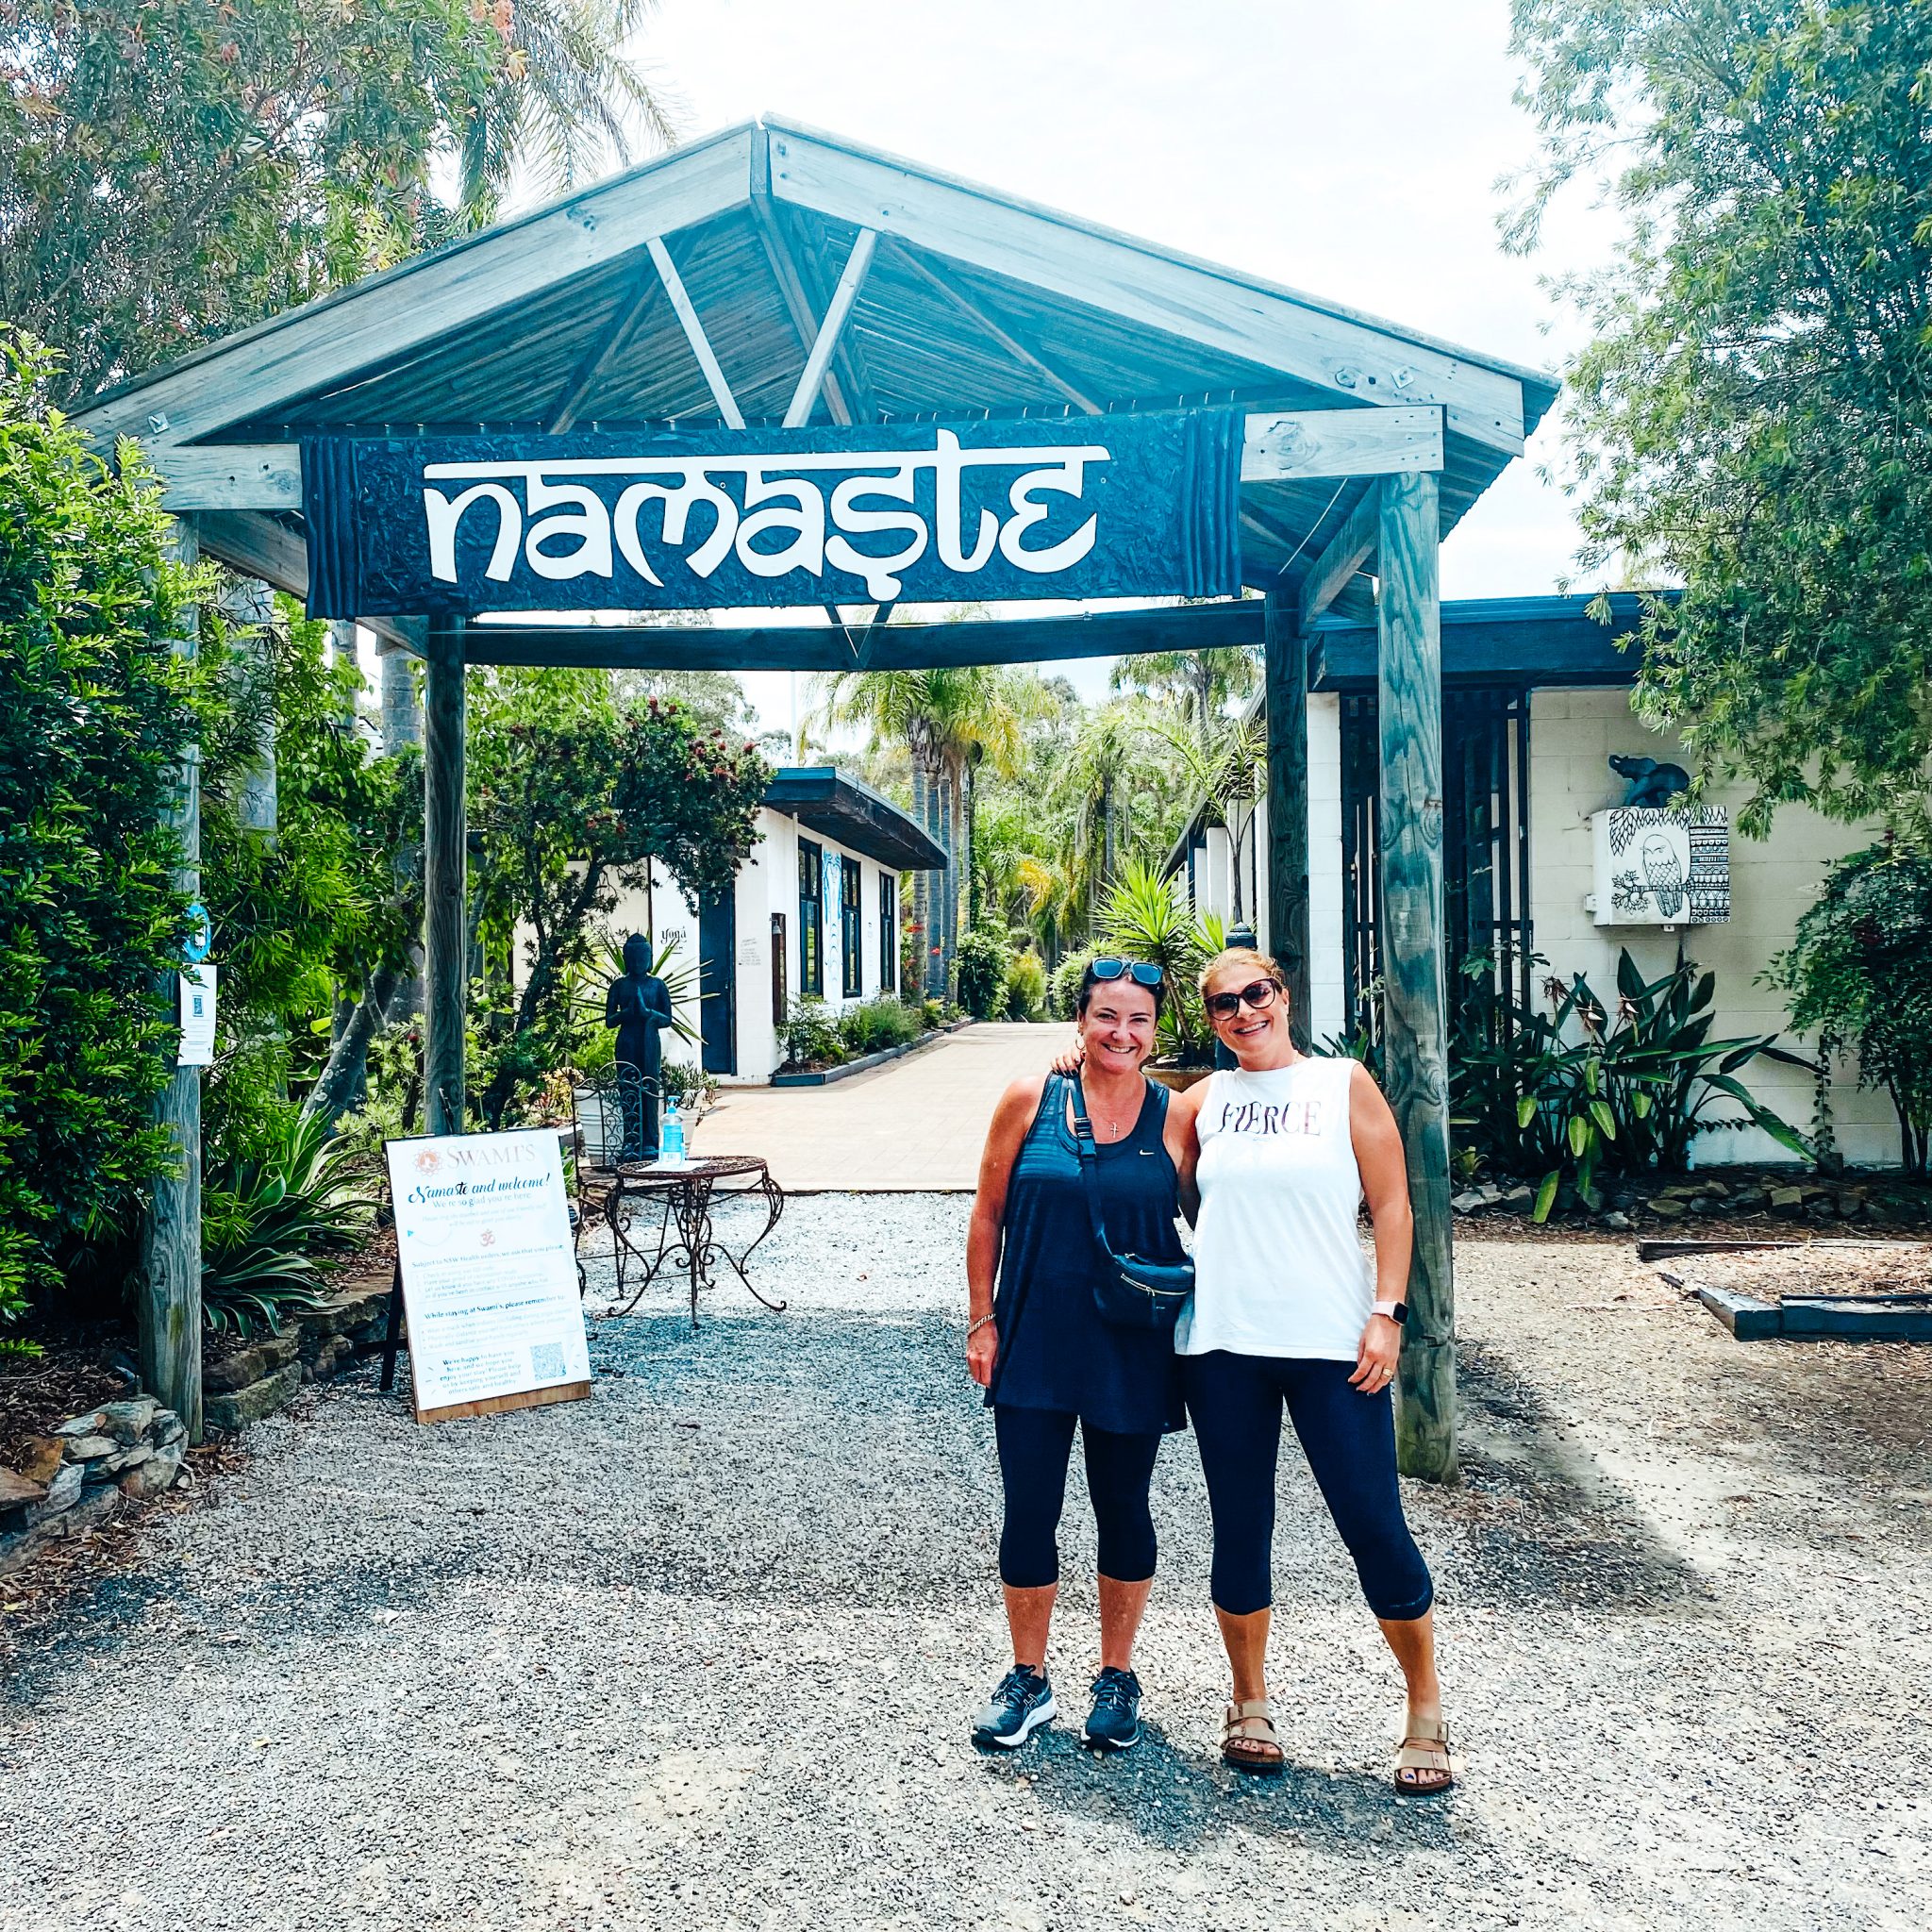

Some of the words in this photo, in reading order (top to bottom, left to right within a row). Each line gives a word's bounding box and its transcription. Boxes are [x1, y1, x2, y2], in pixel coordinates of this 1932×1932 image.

[423, 428, 1111, 603] namaste
[660, 925, 687, 944] yoga
[1218, 1100, 1322, 1137] FIERCE
[446, 1144, 537, 1169] SWAMI'S
[408, 1181, 469, 1204] Namaste
[472, 1178, 496, 1194] and
[497, 1172, 551, 1191] welcome!
[433, 1199, 457, 1208] We're
[468, 1195, 486, 1208] glad
[487, 1193, 513, 1205] you're
[411, 1259, 436, 1269] Subject
[443, 1256, 458, 1264] NSW
[424, 1310, 444, 1320] While
[444, 1307, 470, 1317] staying
[505, 1300, 525, 1310] please
[525, 1295, 557, 1306] remember
[440, 1374, 458, 1383] enjoy
